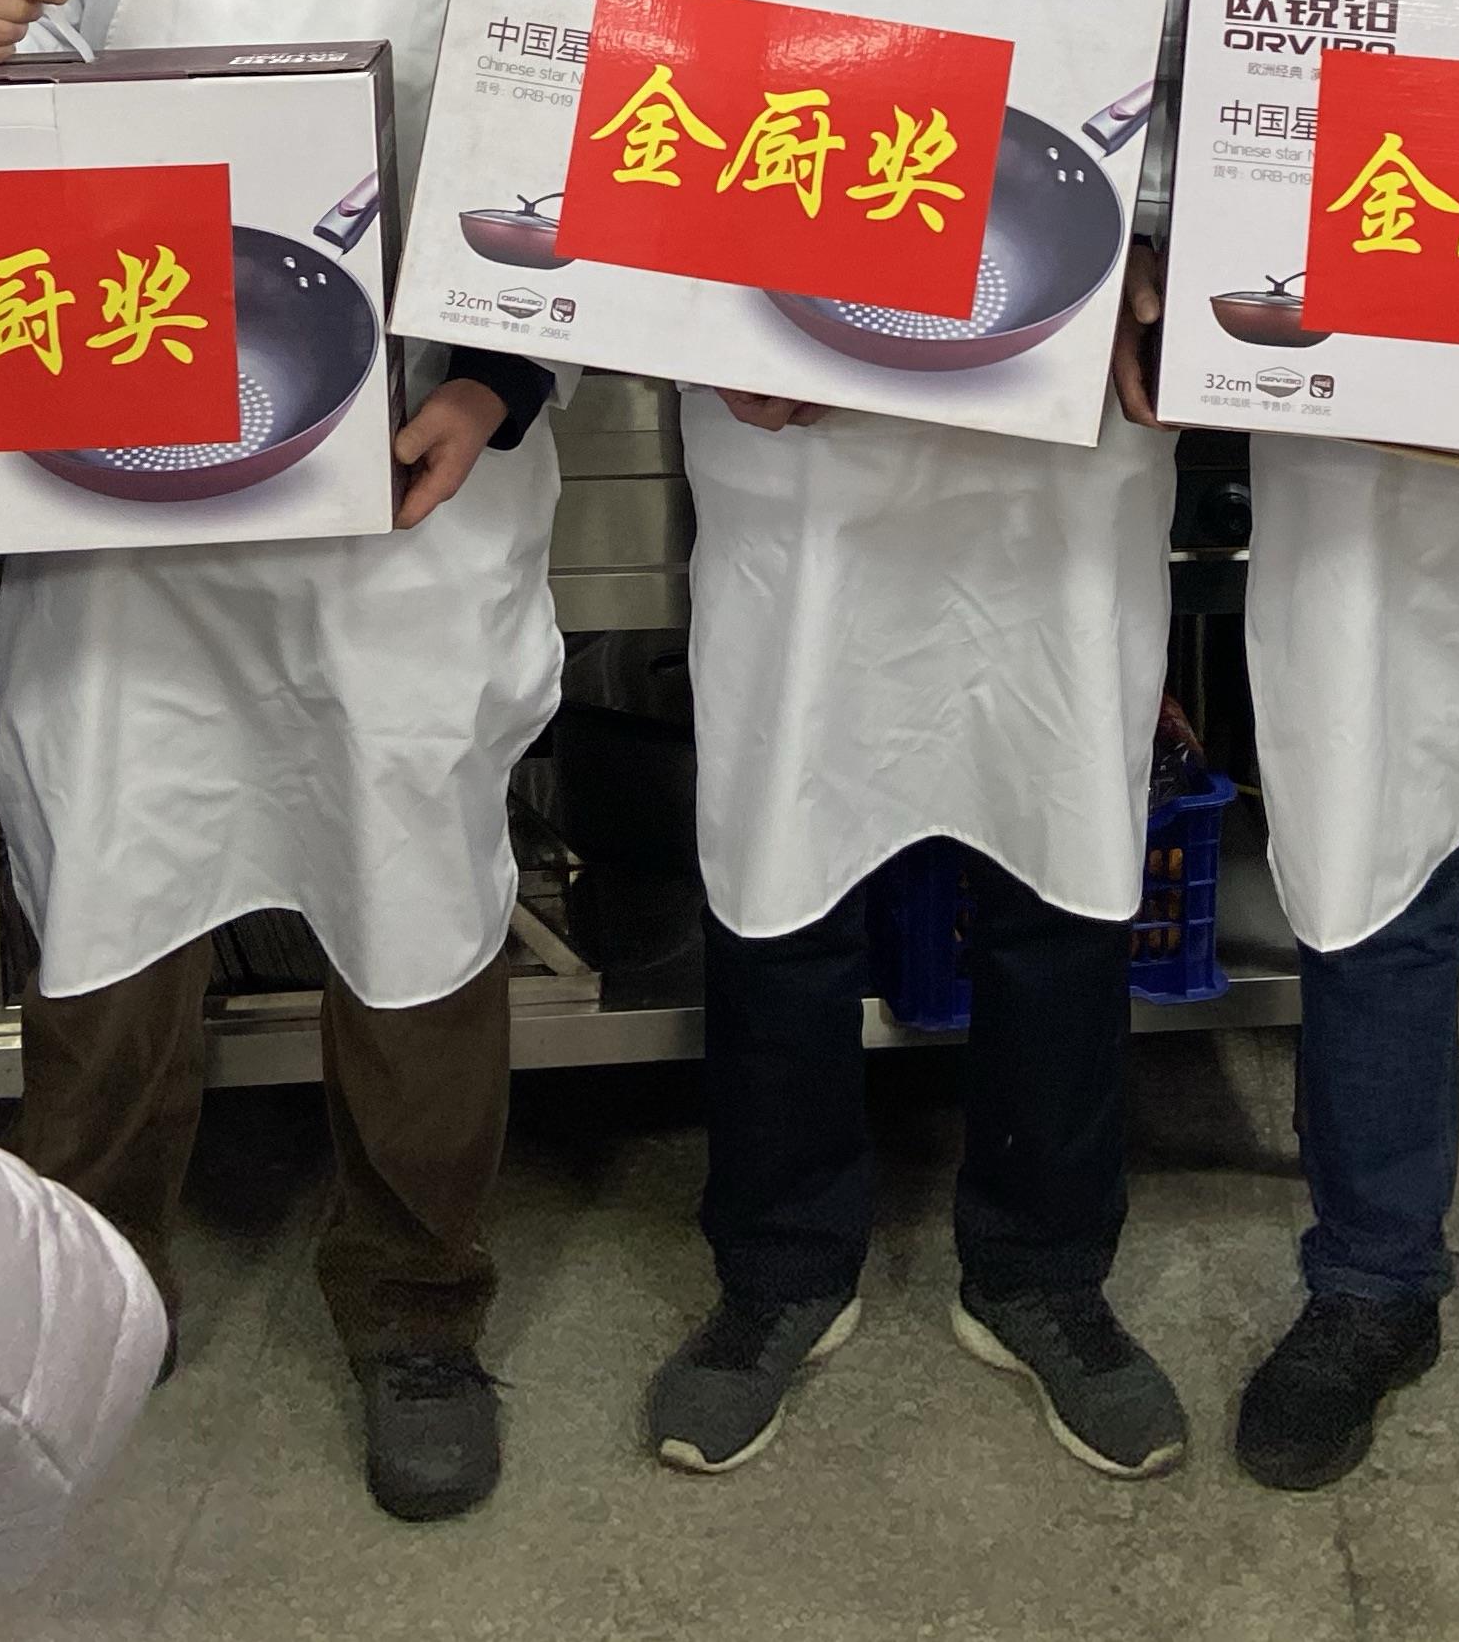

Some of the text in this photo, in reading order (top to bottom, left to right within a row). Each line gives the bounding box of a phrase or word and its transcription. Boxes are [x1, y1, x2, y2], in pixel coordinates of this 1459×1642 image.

[487, 16, 590, 64] 中国星
[477, 55, 535, 77] Chinese
[540, 67, 566, 82] star
[1248, 62, 1303, 79] 欧洲经典
[1220, 100, 1318, 141] 中国星
[590, 64, 966, 233] 金厨奖
[1213, 140, 1270, 158] Chinese
[1275, 147, 1303, 160] star
[445, 290, 493, 311] 32cm
[1204, 373, 1251, 392] 32cm
